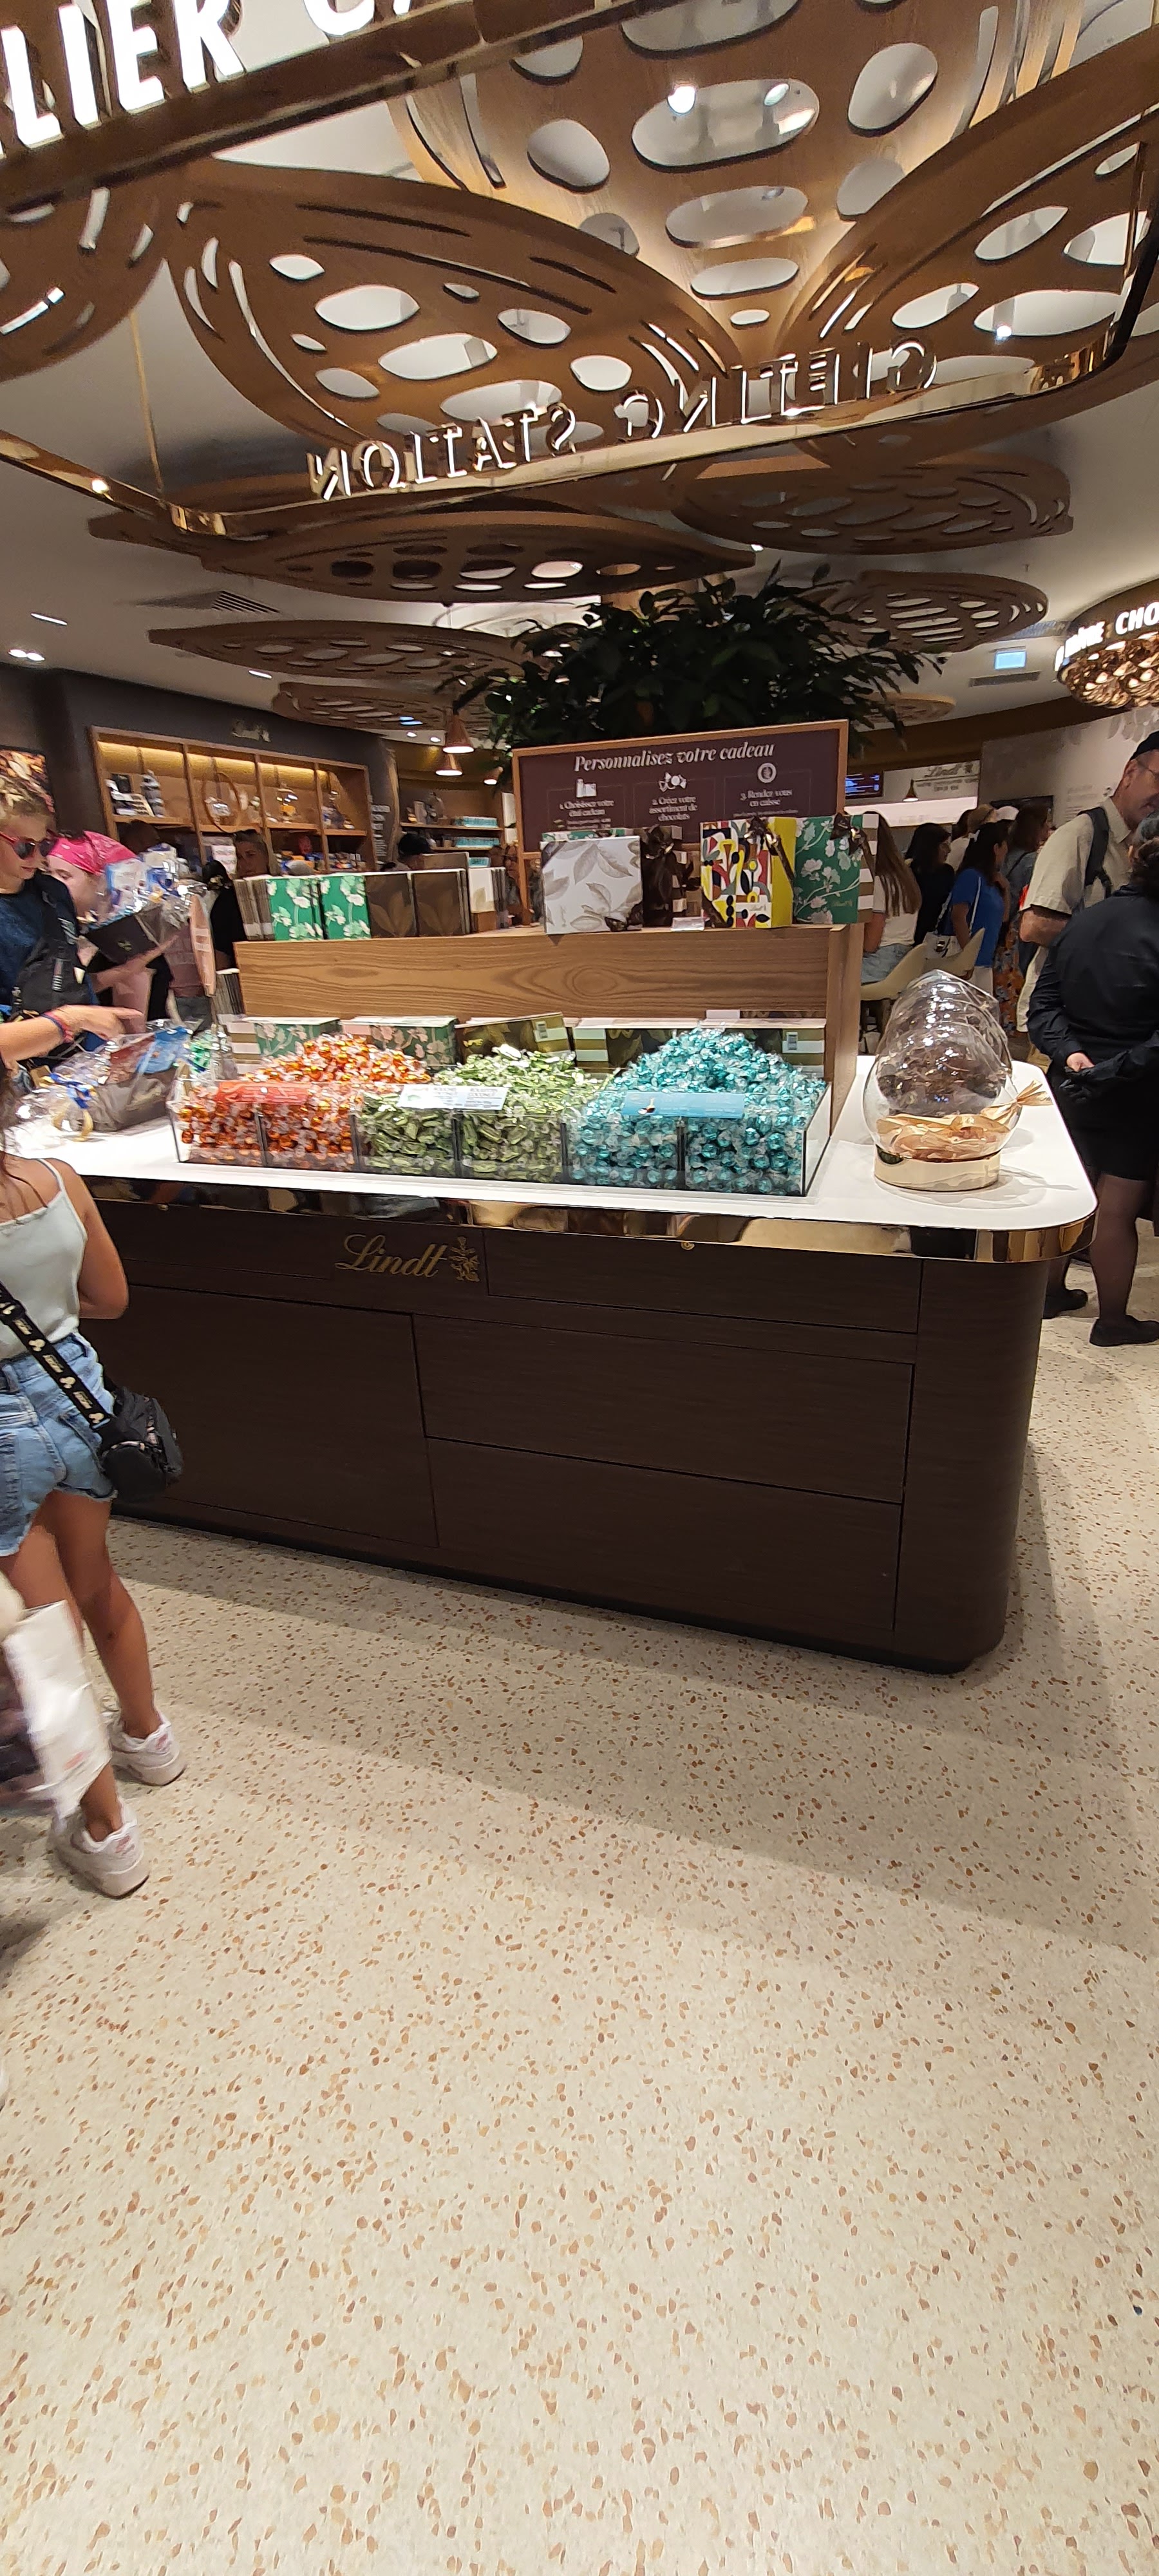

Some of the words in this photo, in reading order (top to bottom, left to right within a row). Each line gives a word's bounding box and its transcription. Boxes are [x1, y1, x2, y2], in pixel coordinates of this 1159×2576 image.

[0, 0, 246, 158] LIER
[574, 750, 674, 772] Personnalisez
[677, 747, 717, 764] votre
[719, 741, 775, 761] cadeau
[334, 1234, 448, 1278] Lindt
